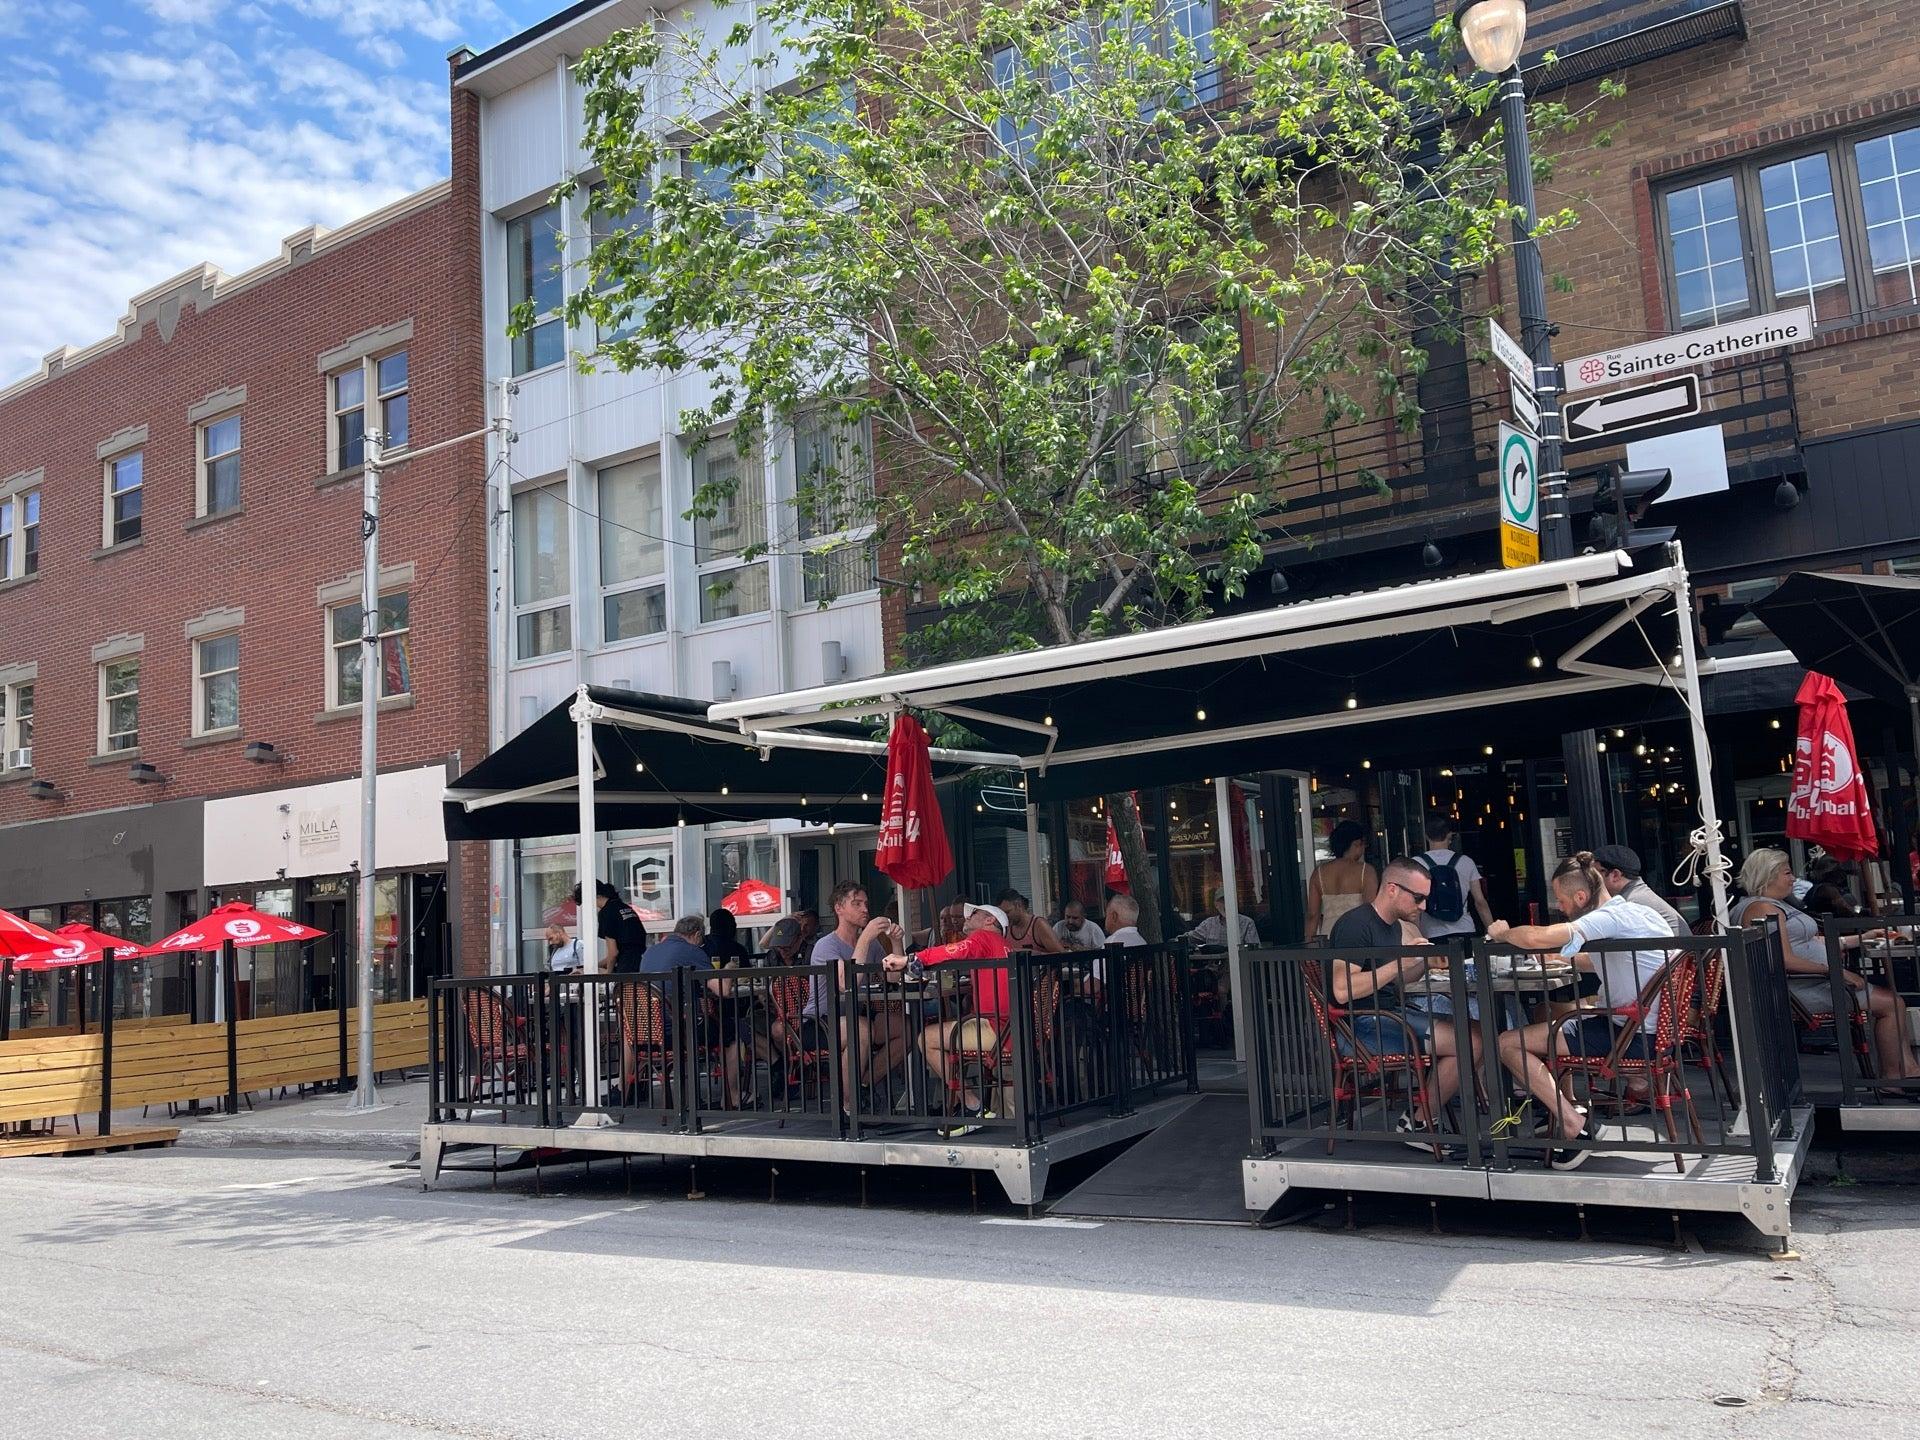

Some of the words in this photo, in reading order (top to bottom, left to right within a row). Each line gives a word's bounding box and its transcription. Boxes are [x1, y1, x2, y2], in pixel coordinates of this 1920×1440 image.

[1606, 352, 1622, 362] Rue
[1607, 325, 1799, 378] Sainte-Catherine
[300, 819, 338, 836] MILLA
